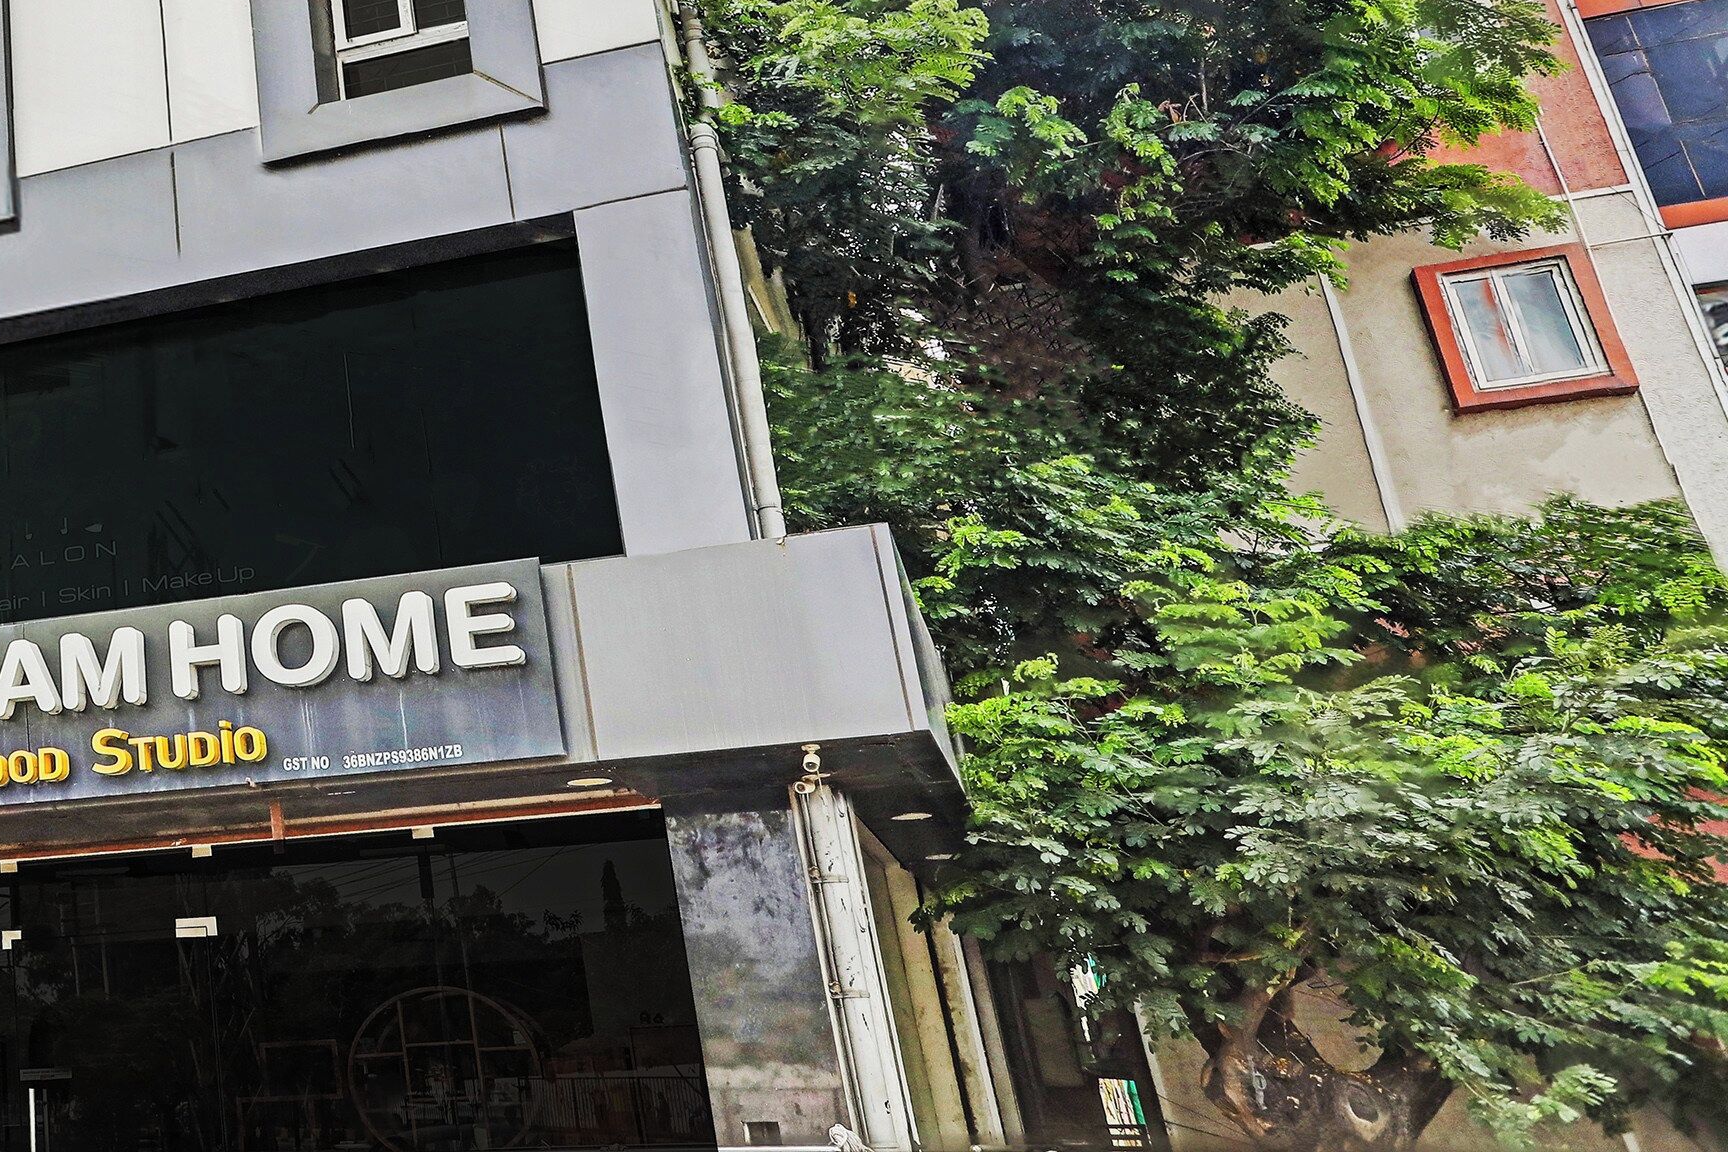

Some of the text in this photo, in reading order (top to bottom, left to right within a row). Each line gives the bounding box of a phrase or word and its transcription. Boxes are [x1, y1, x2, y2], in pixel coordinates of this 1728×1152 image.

[58, 583, 112, 605] Skin
[168, 581, 527, 701] HOME
[283, 756, 308, 771] GST
[310, 755, 331, 770] NO
